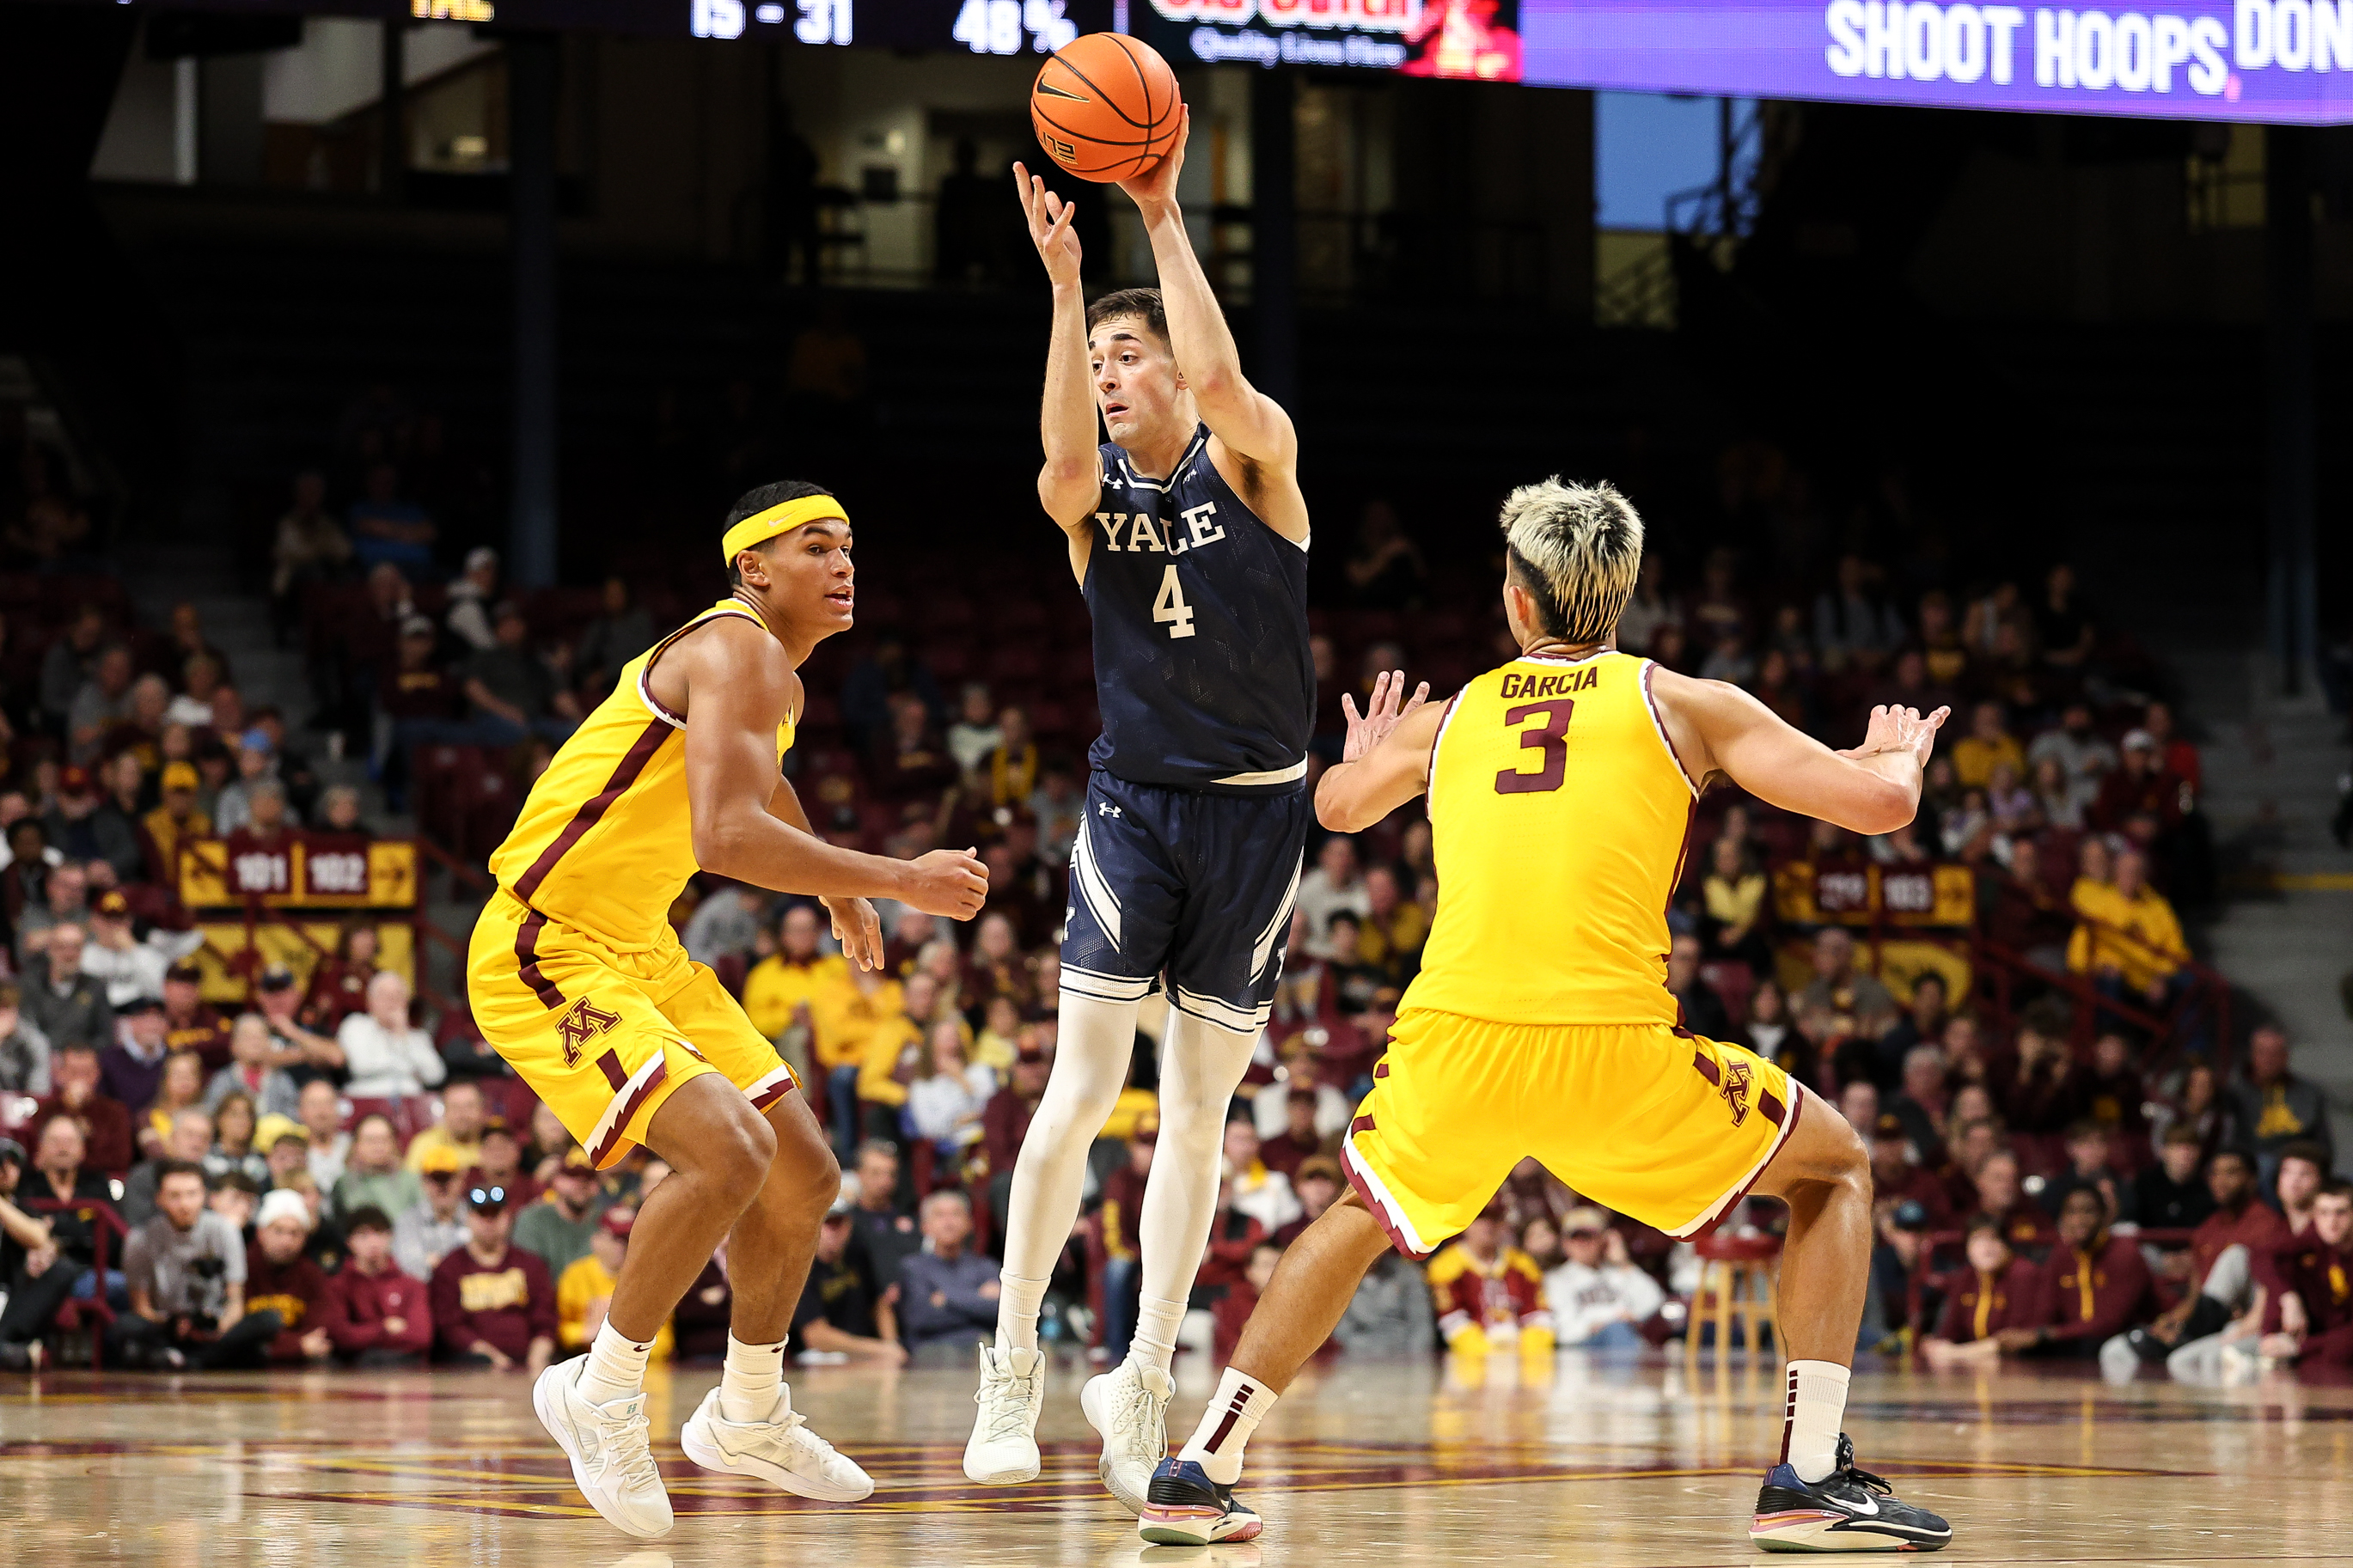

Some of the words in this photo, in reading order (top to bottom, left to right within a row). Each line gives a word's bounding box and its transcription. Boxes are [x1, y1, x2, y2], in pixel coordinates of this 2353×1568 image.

[690, 0, 746, 39] 15
[793, 0, 853, 46] 31
[953, 0, 1079, 55] 48%
[1824, 0, 2026, 85] SHOOT
[2234, 0, 2353, 73] DON
[1095, 501, 1226, 555] YALE
[1152, 564, 1196, 638] 4
[1500, 667, 1598, 698] GARCIA
[1494, 699, 1574, 795] 3
[555, 996, 623, 1068] M
